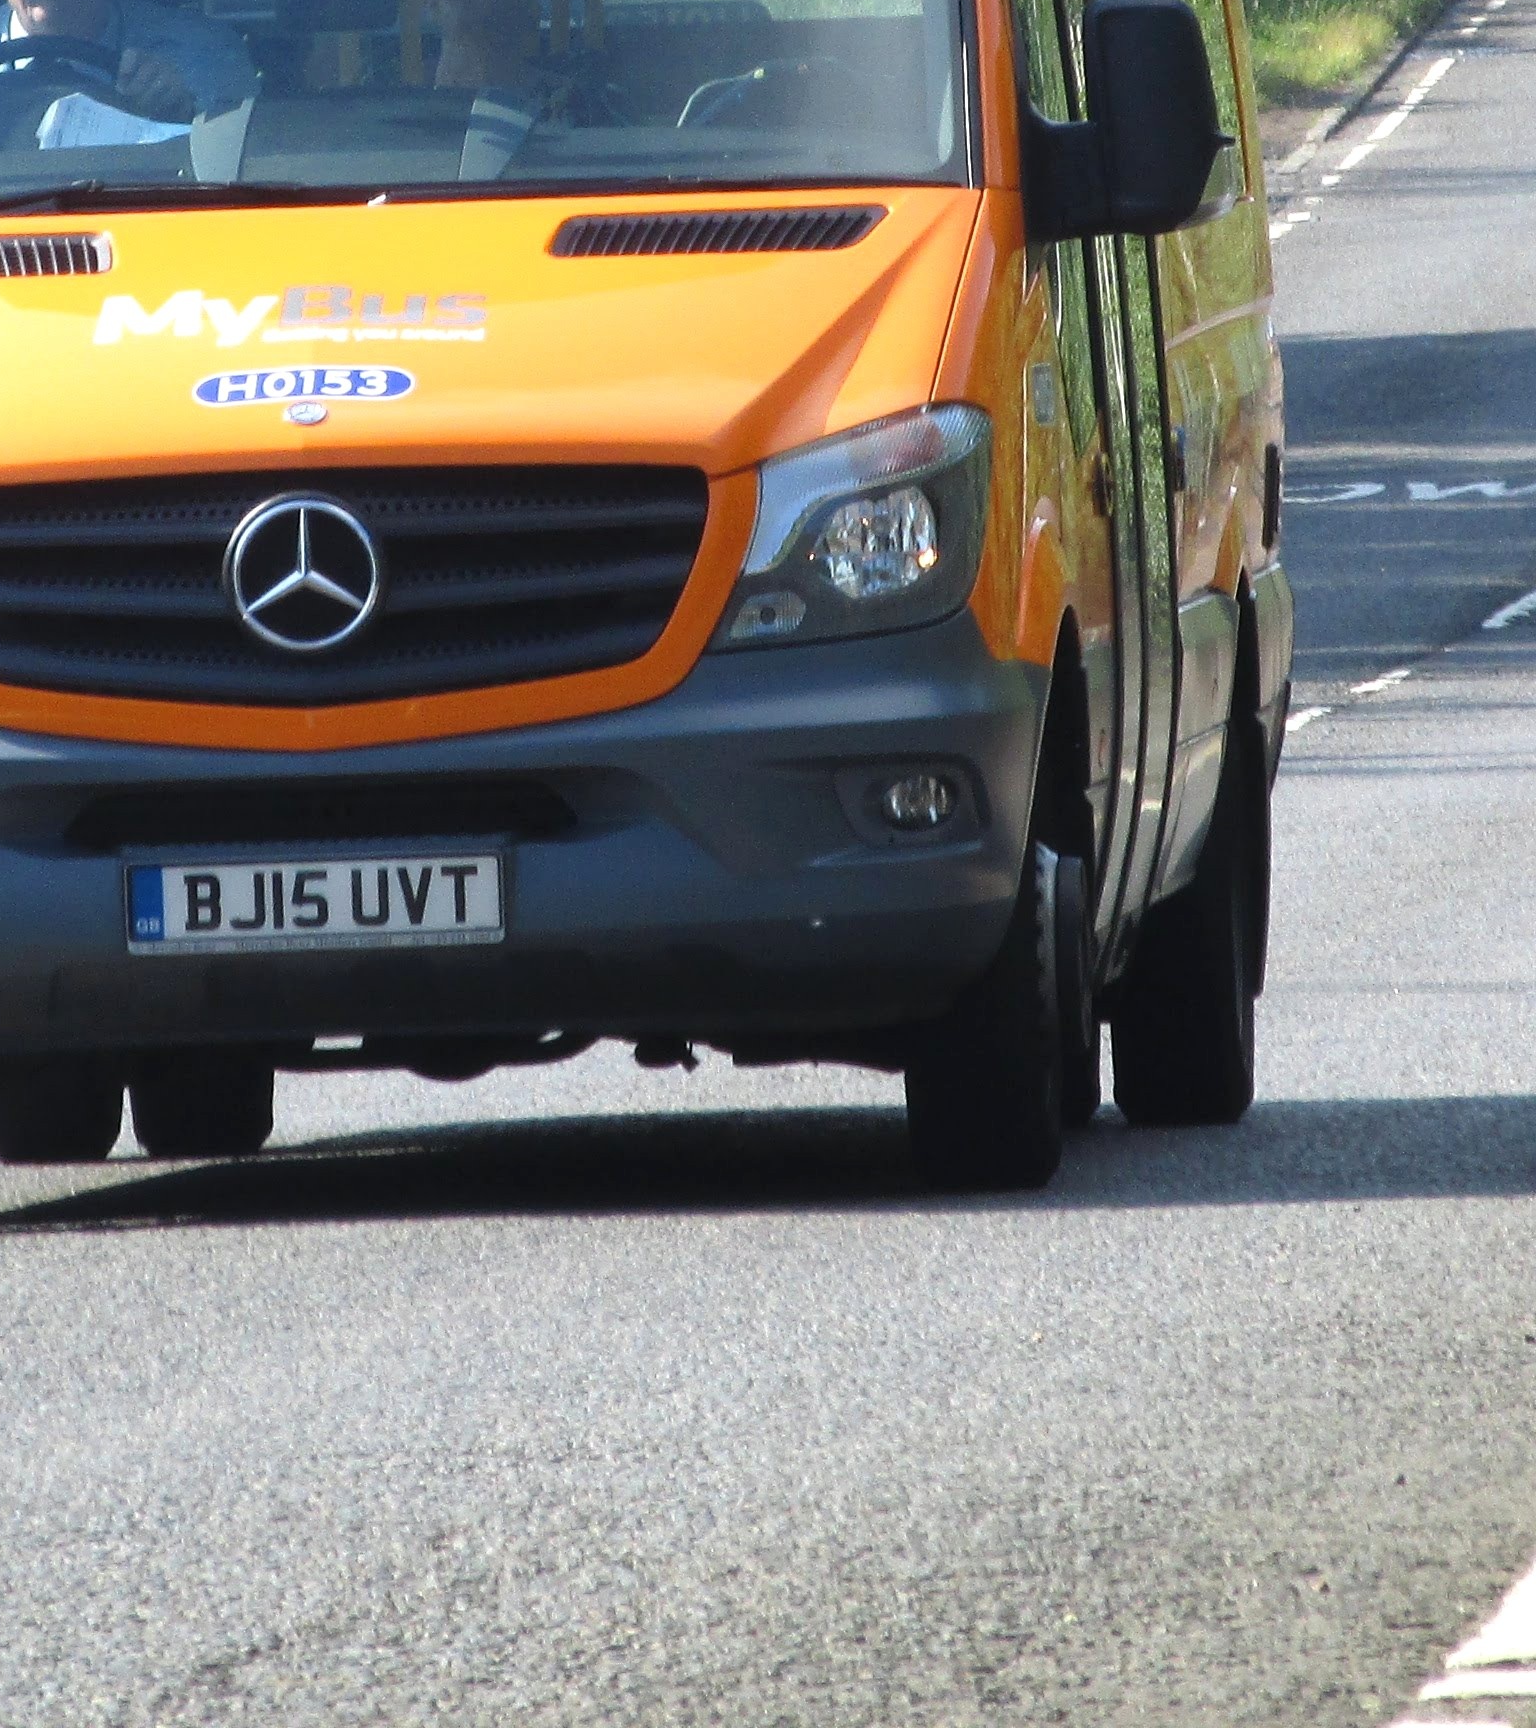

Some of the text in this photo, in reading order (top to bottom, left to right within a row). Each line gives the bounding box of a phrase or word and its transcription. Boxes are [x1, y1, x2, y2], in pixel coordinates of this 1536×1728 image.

[92, 285, 489, 347] MyBus
[183, 865, 479, 931] BJ15 UVT
